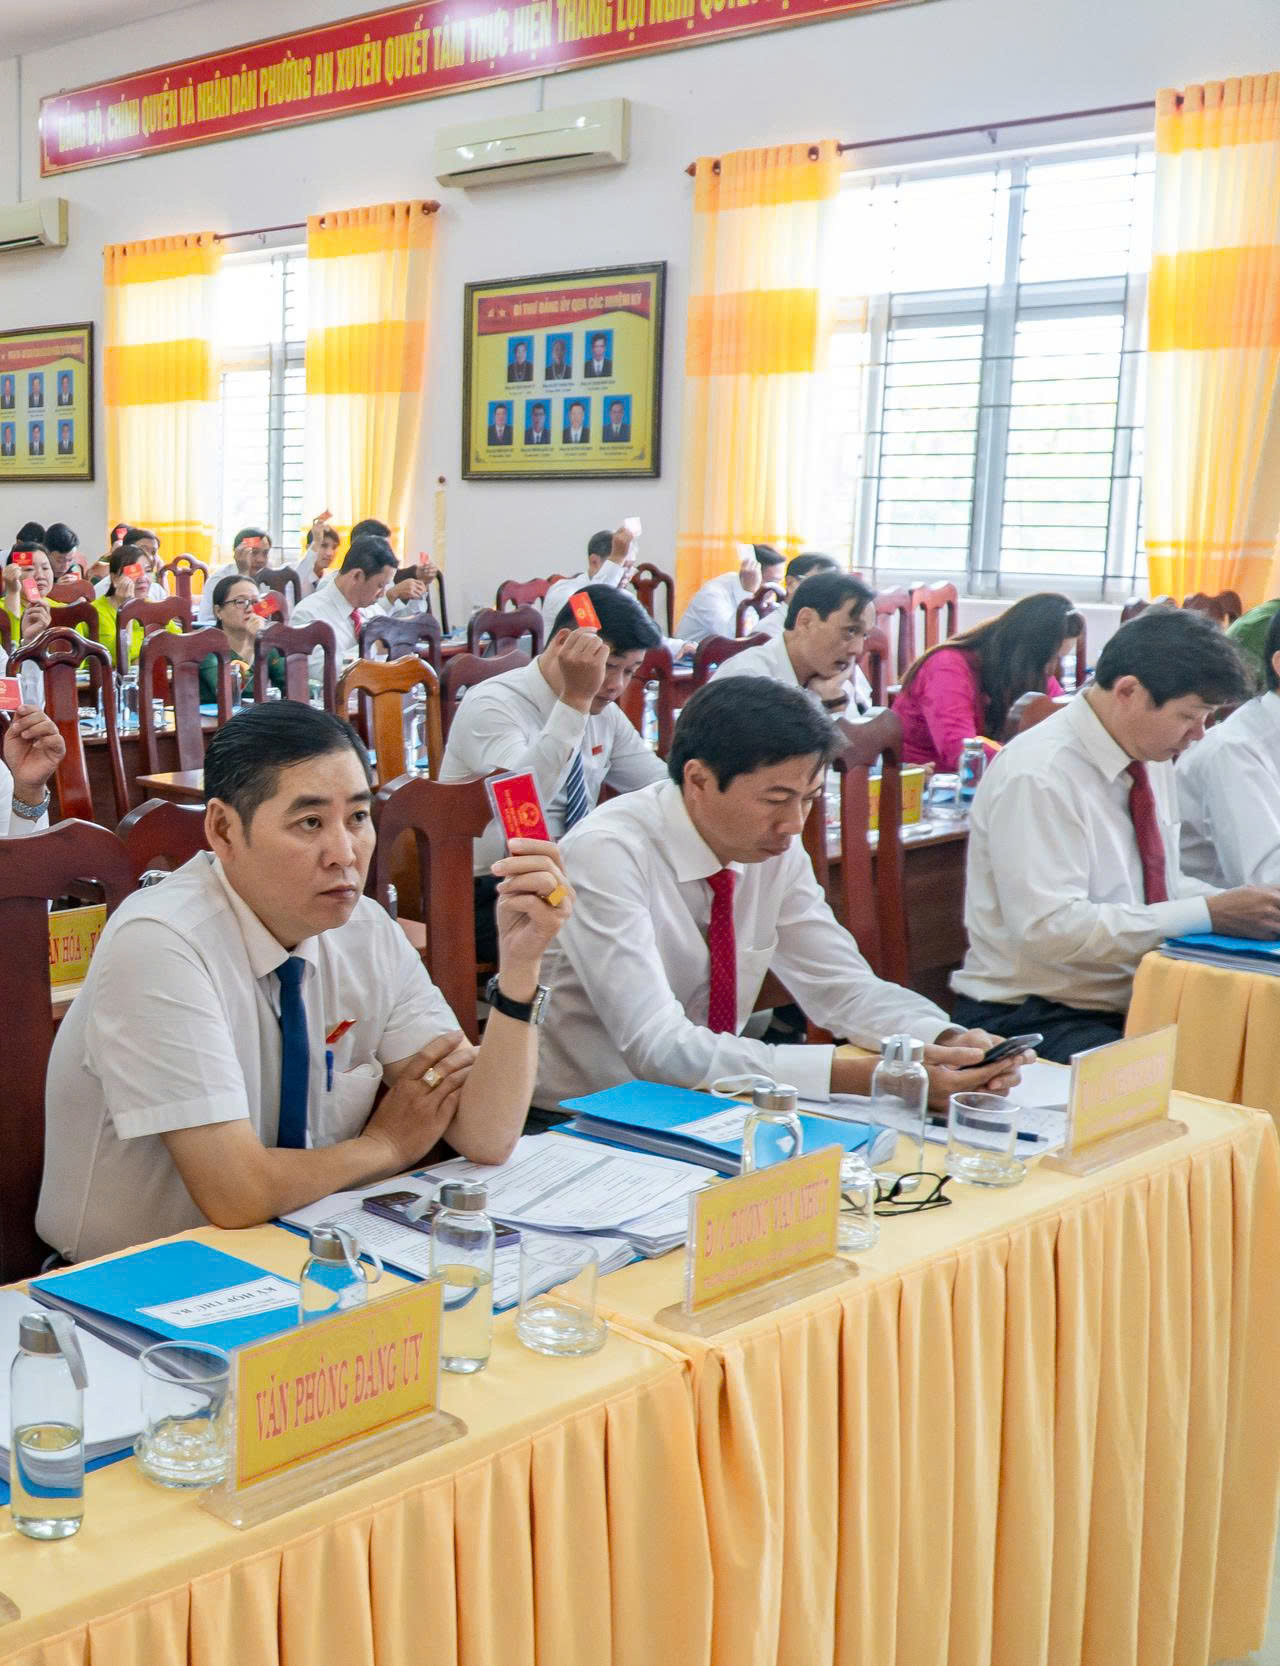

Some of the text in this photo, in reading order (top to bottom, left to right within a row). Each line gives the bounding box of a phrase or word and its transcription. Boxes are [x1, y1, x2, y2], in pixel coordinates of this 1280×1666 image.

[141, 77, 178, 138] QUYỀN
[179, 77, 195, 127] VÀ
[197, 70, 230, 122] NHÂN
[231, 63, 258, 115] DÂN
[259, 50, 312, 108] PHƯỜNG
[313, 51, 334, 97] AN
[335, 33, 381, 92] XUYÊN
[384, 13, 431, 86] QUYẾT
[432, 14, 465, 71] TÂM
